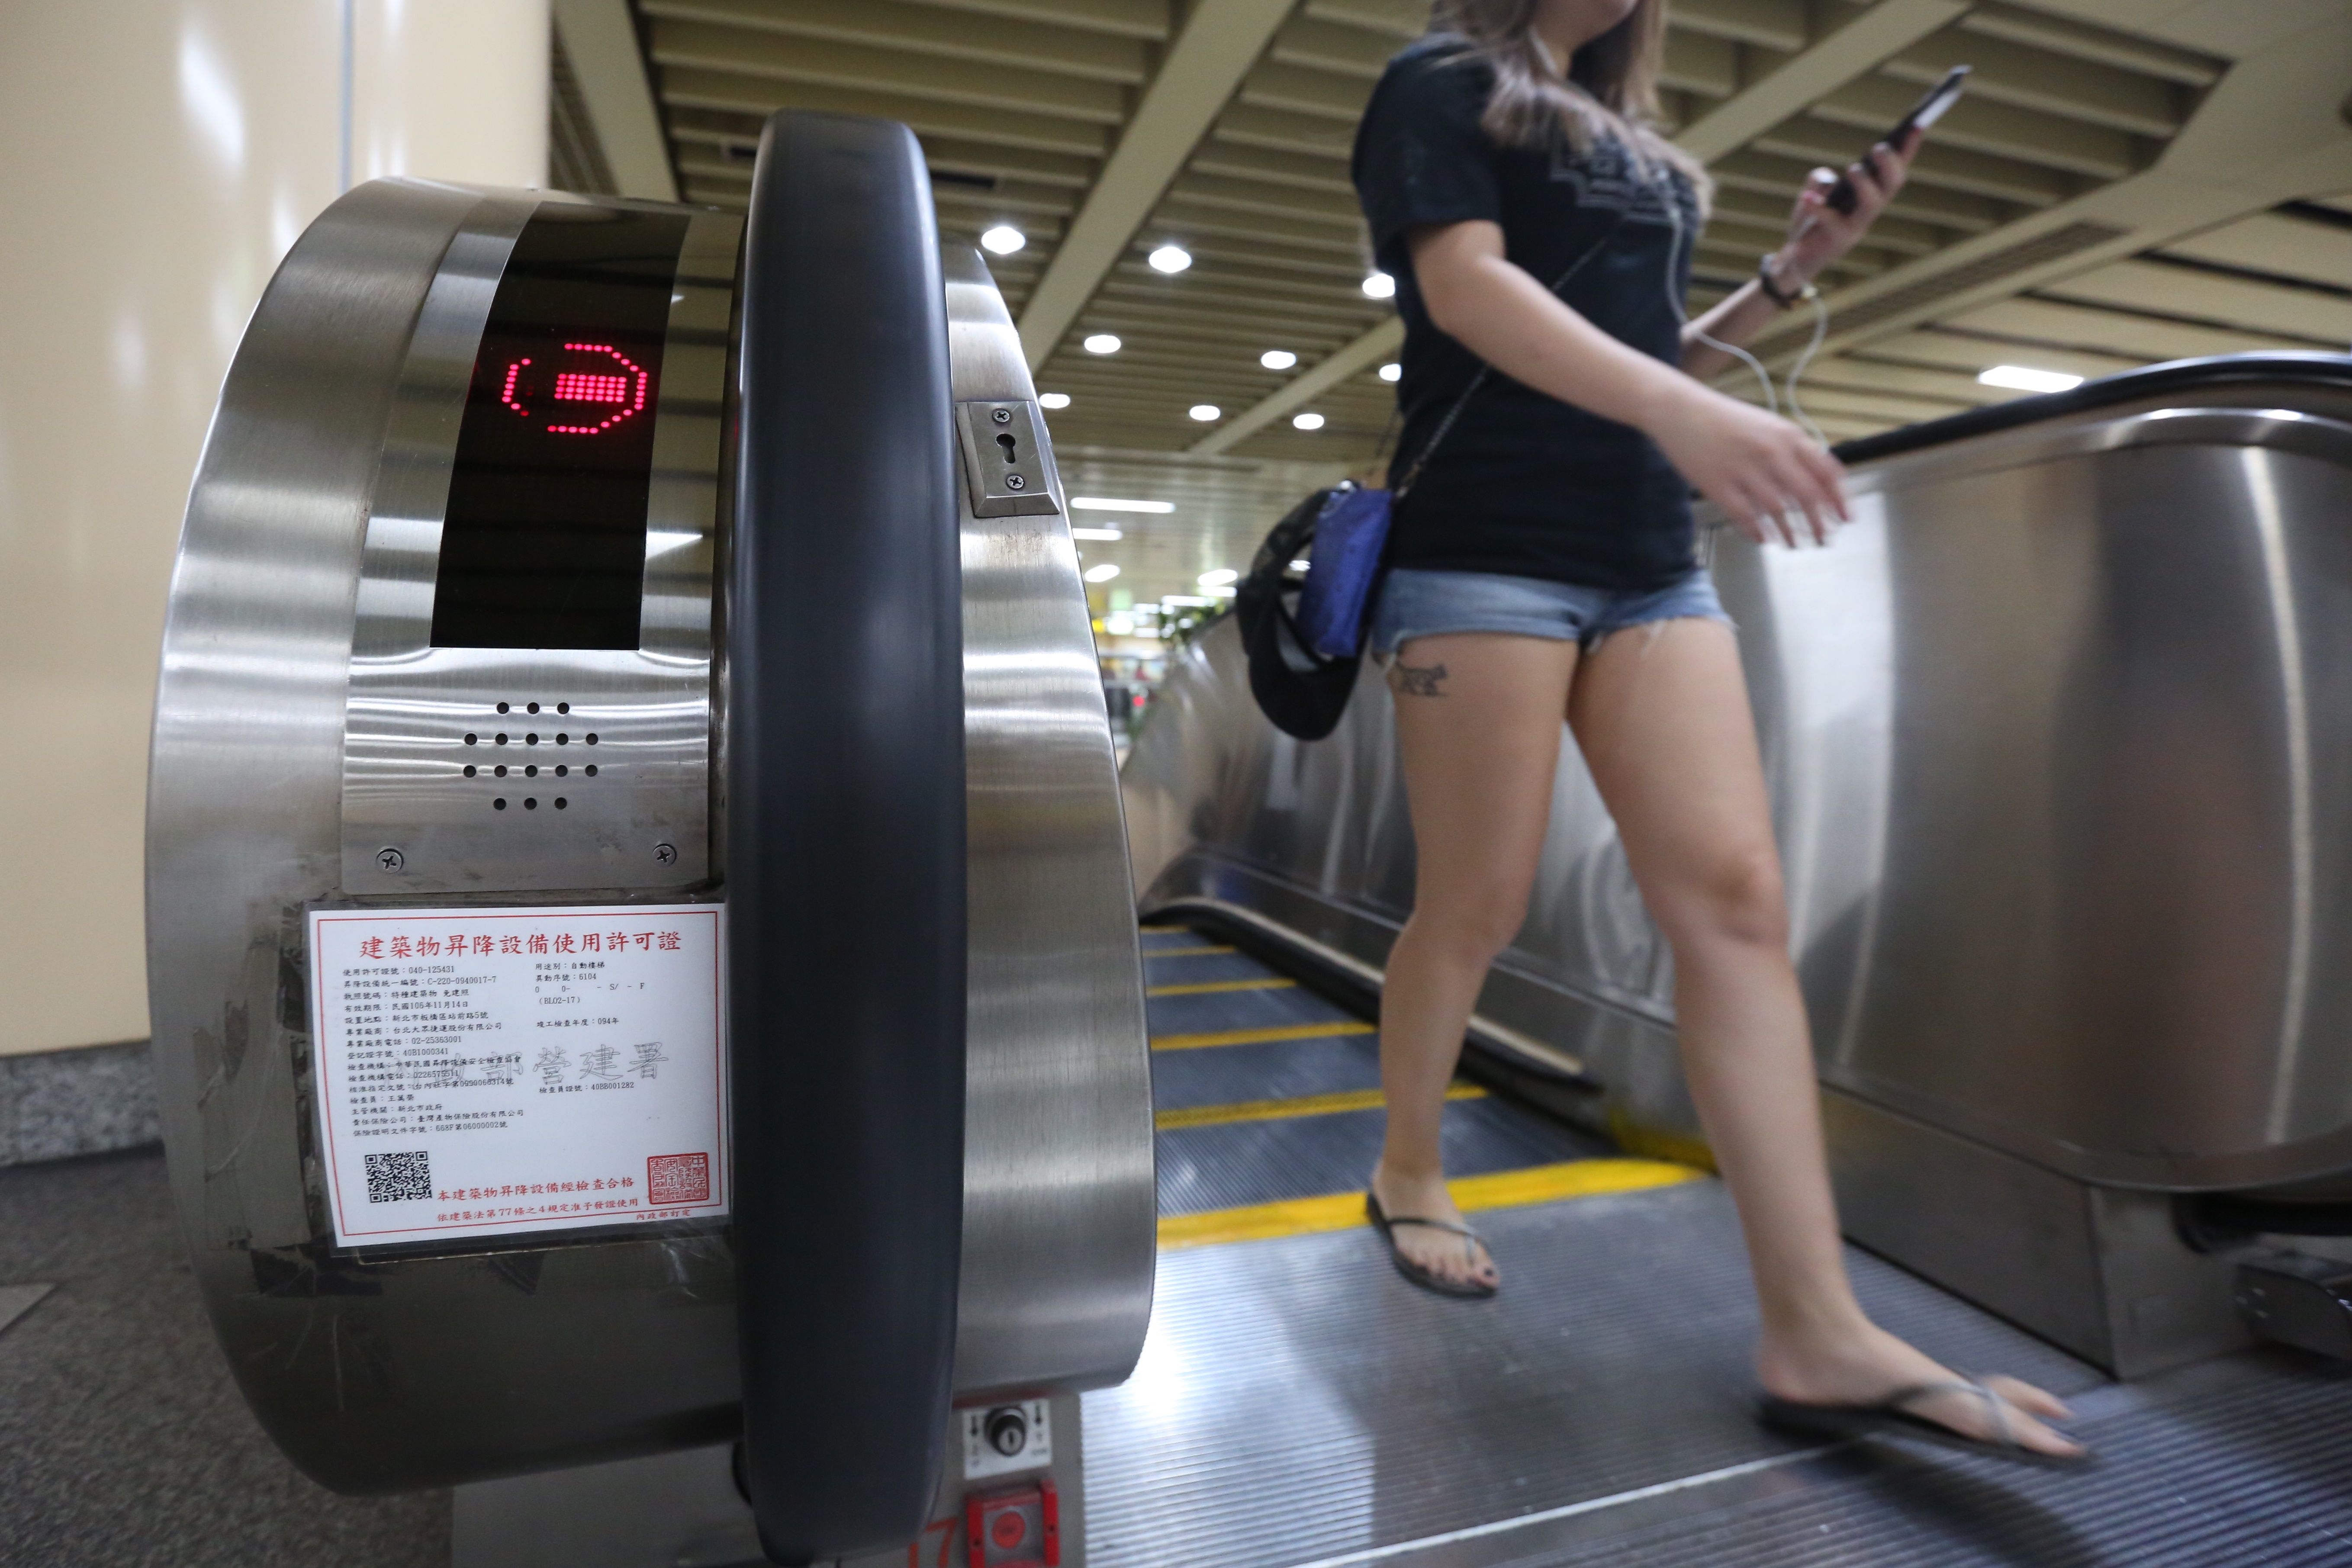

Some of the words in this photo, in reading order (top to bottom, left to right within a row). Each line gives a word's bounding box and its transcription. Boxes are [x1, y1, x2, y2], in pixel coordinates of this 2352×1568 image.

[359, 931, 682, 959] 建築物昇降設備使用許可證
[535, 961, 605, 970] 用途別：自動樓梯
[344, 1001, 468, 1012] 有效期限：民國106年11月14日
[438, 1177, 634, 1202] 本建築物昇降設備經檢查合格
